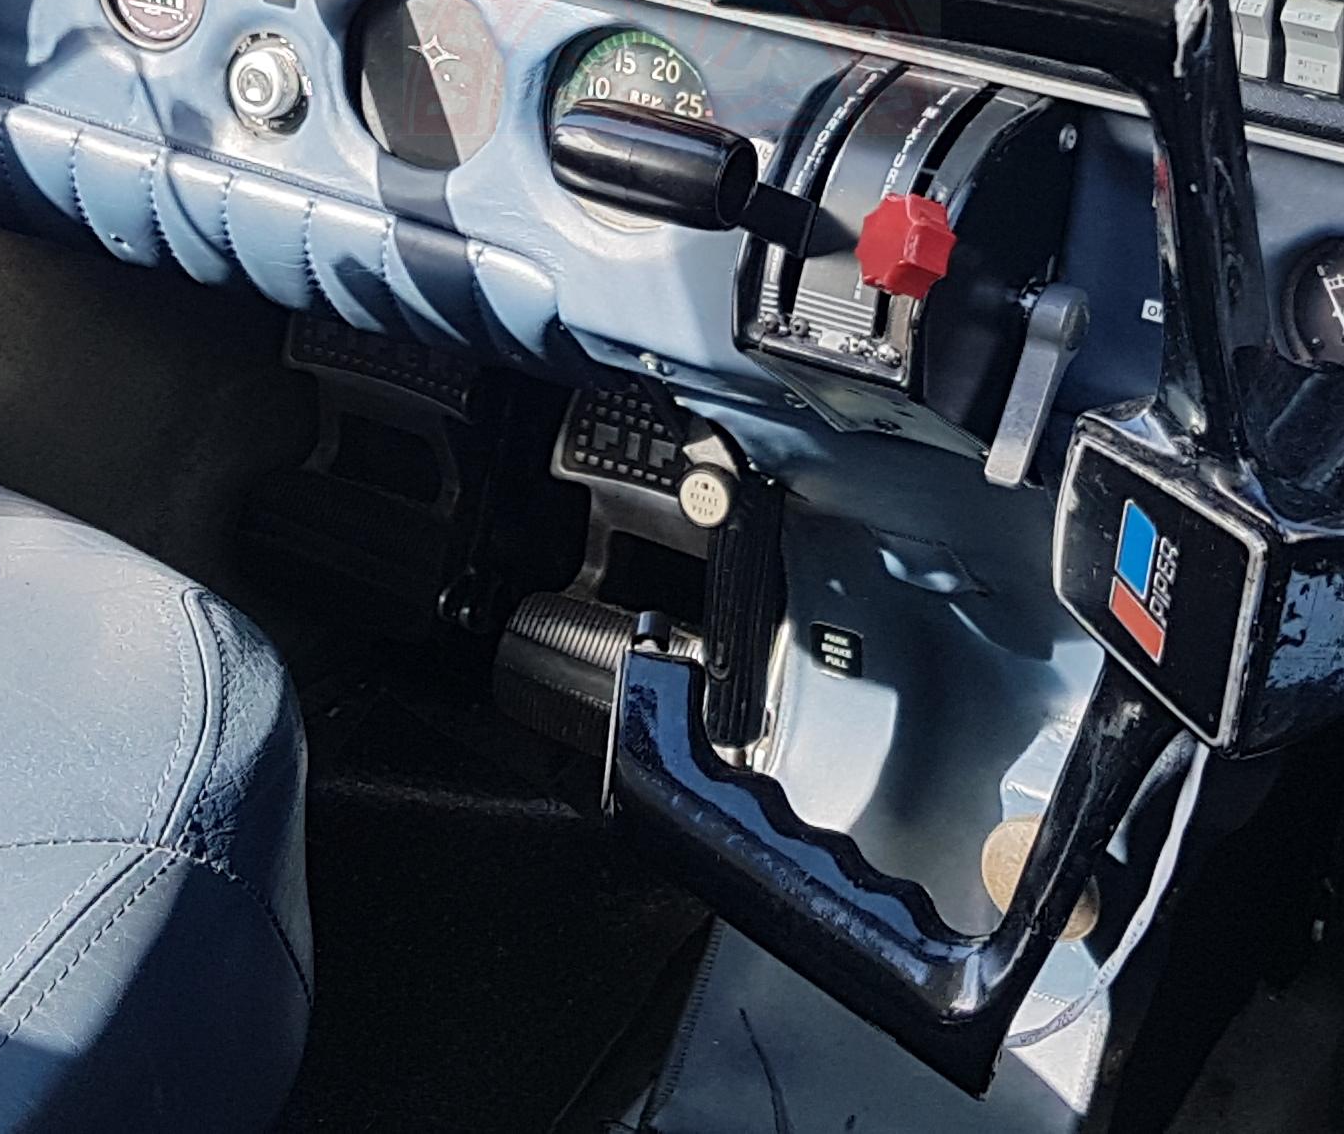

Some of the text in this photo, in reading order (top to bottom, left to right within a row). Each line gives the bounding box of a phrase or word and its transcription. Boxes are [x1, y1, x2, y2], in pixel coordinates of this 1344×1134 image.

[614, 48, 636, 76] 15
[651, 58, 680, 84] 20
[674, 91, 702, 117] 25
[1150, 536, 1180, 629] PIPER
